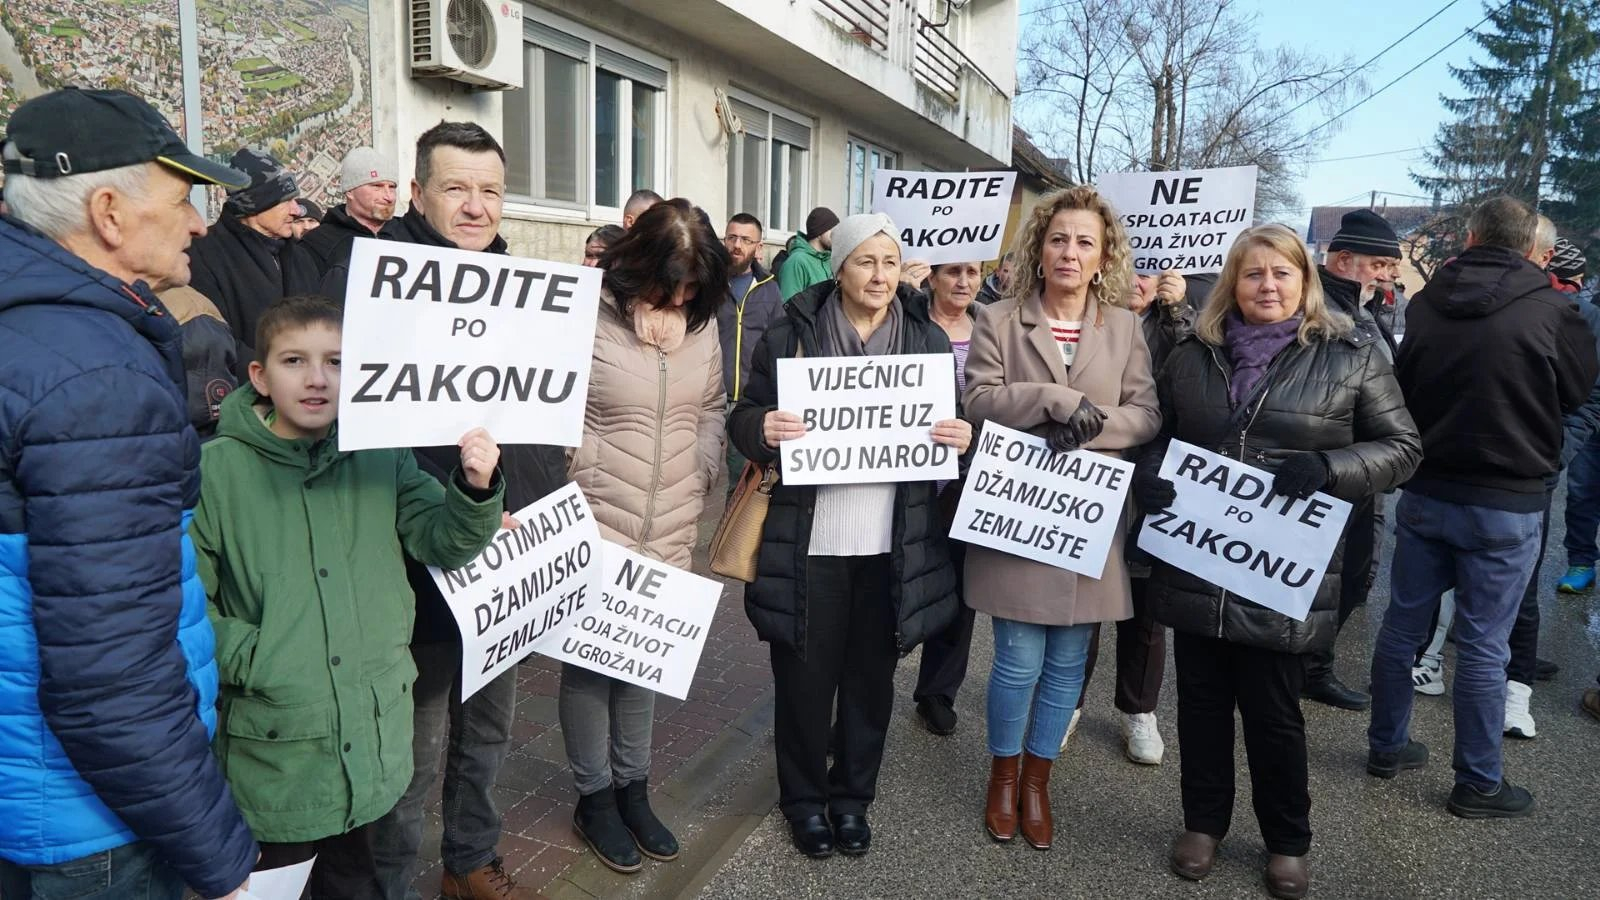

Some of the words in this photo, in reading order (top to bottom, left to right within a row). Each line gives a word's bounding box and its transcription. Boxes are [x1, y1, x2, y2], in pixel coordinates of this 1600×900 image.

[885, 177, 1004, 200] RADITE
[1150, 177, 1203, 205] NE
[931, 206, 953, 216] PO
[1118, 208, 1247, 228] SPLOATACIJI
[900, 224, 1000, 248] AKONU
[1128, 236, 1163, 250] OJA
[1168, 232, 1227, 249] ŽIVOT
[1134, 254, 1223, 271] GROŽAVA
[370, 255, 578, 314] RADITE
[451, 317, 487, 338] PO
[351, 363, 577, 404] ZAKONU
[808, 361, 924, 391] VIJEĆNICI
[803, 405, 893, 432] BUDITE
[901, 403, 934, 427] UZ
[790, 447, 852, 472] SVOJ
[858, 443, 948, 469] NAROD
[980, 431, 1005, 457] NE
[1005, 440, 1125, 491] OTIMAJTE
[974, 469, 1104, 524] DŽAMIJSKO
[1176, 453, 1333, 528] RADITE
[968, 508, 1088, 560] ZEMLJIŠTE
[1224, 505, 1254, 524] PO
[441, 560, 482, 595] NE
[482, 493, 586, 571] OTIMAJTE
[1149, 510, 1315, 588] ZAKONU
[474, 540, 592, 637] DŽAMIJSKO
[614, 559, 668, 600] NE
[481, 584, 588, 675] ZEMLJIŠTE
[602, 592, 702, 641] PLOATACIJI
[574, 616, 612, 639] OJA
[612, 624, 675, 659] ŽIVOT
[562, 637, 664, 684] UGROŽAVA
